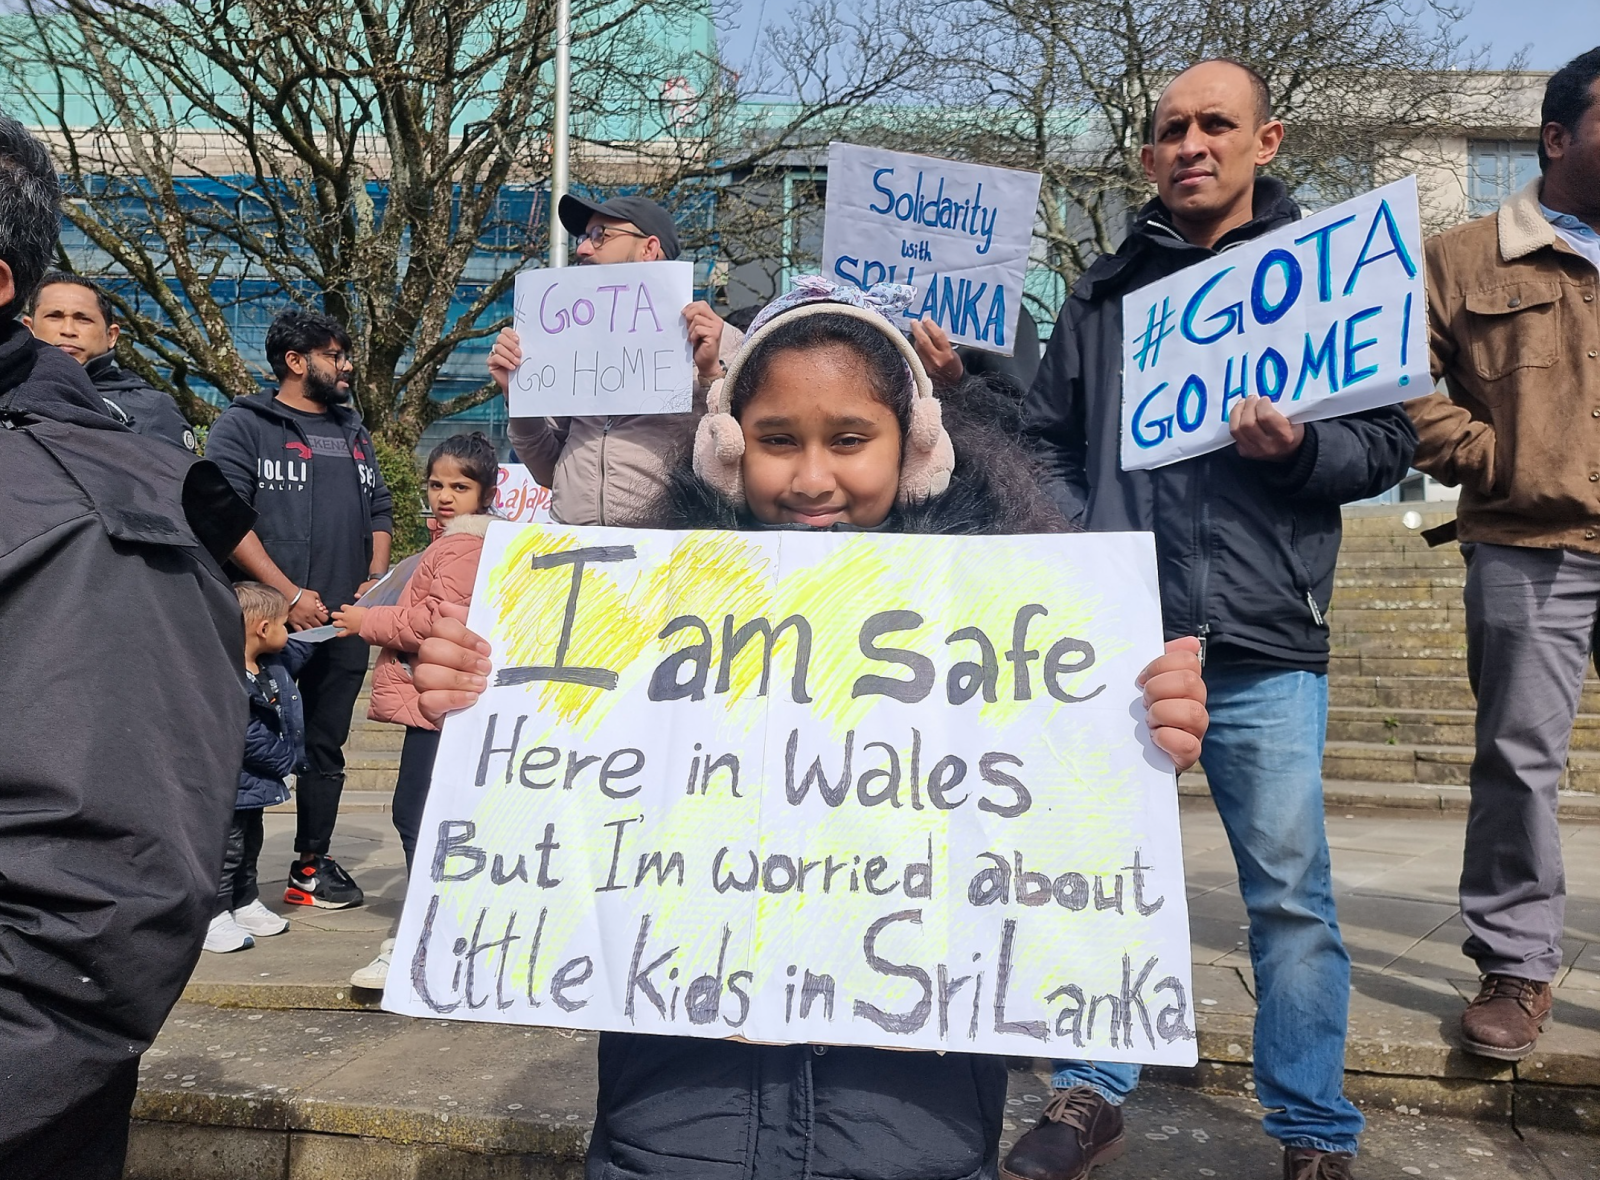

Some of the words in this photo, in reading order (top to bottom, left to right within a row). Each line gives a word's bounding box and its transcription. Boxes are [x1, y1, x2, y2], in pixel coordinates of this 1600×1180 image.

[870, 168, 997, 254] Solidarity
[901, 239, 932, 262] with
[1133, 199, 1417, 372] #GOTA
[1131, 374, 1208, 449] GO
[493, 544, 637, 691] I
[647, 613, 813, 705] am
[474, 713, 646, 799] Here
[686, 742, 743, 798] in
[784, 726, 1033, 819] Wales
[430, 819, 562, 890] But
[594, 813, 684, 892] I'm
[712, 831, 933, 900] worried
[968, 850, 1165, 916] about
[786, 963, 836, 1025] in
